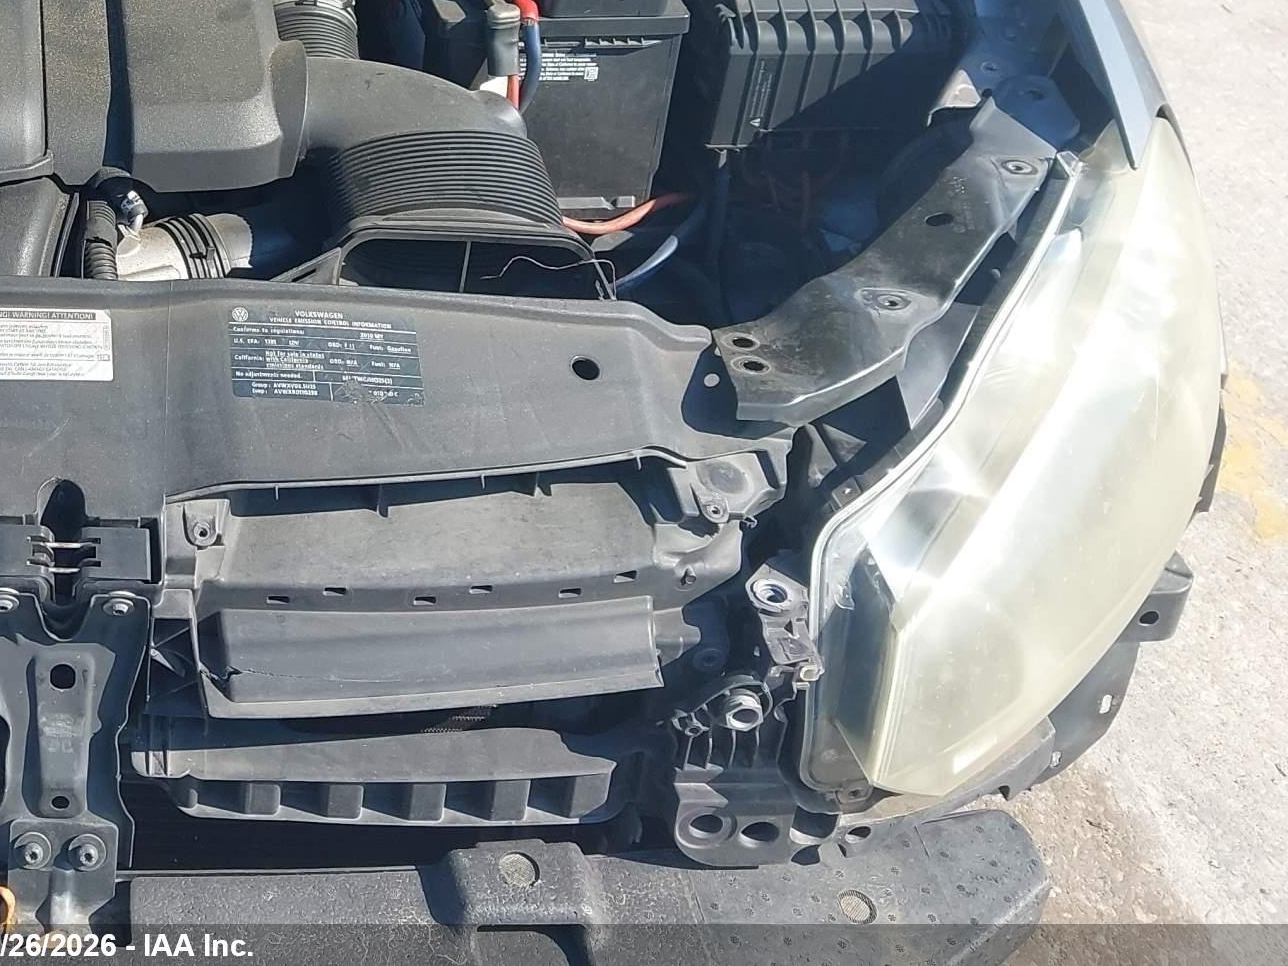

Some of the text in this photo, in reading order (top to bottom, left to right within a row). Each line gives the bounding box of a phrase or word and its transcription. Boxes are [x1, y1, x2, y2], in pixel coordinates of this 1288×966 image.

[11, 311, 50, 320] WARNING!
[51, 312, 94, 320] ATTENTION!
[295, 310, 343, 319] VOLKSWAGEN
